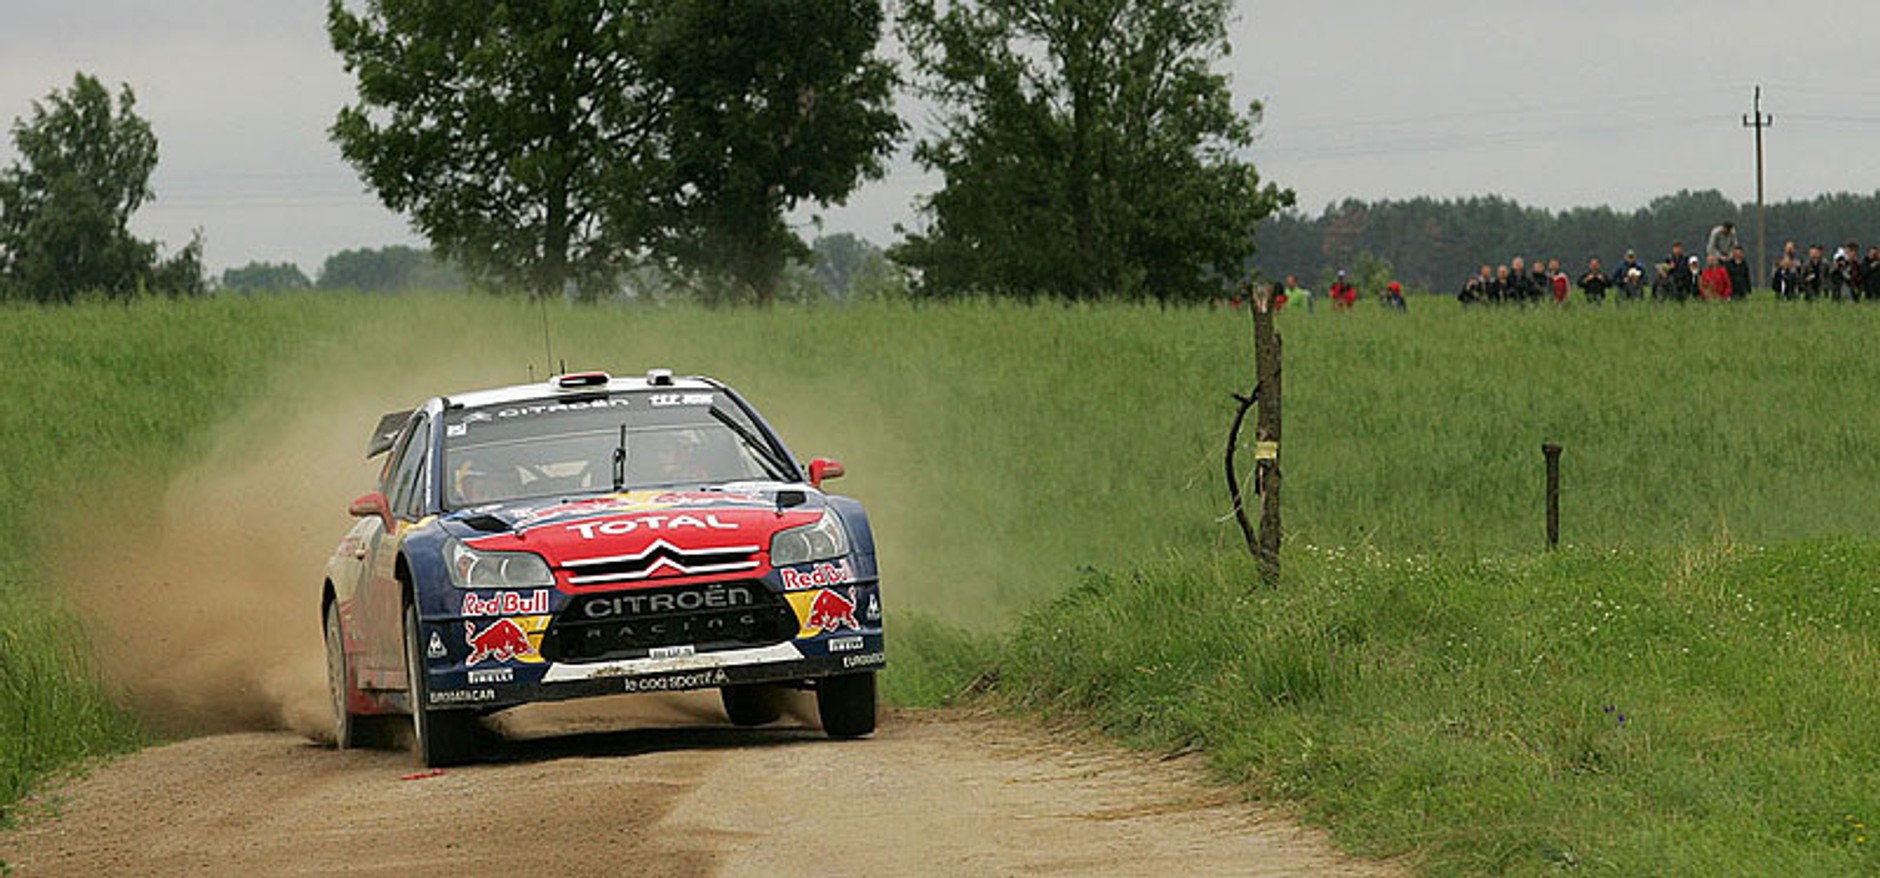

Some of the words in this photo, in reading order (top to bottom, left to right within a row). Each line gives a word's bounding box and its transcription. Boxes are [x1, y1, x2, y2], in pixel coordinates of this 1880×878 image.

[566, 514, 740, 540] TOTAL
[780, 563, 825, 590] Red
[461, 590, 501, 616] Red
[502, 589, 549, 614] Bull
